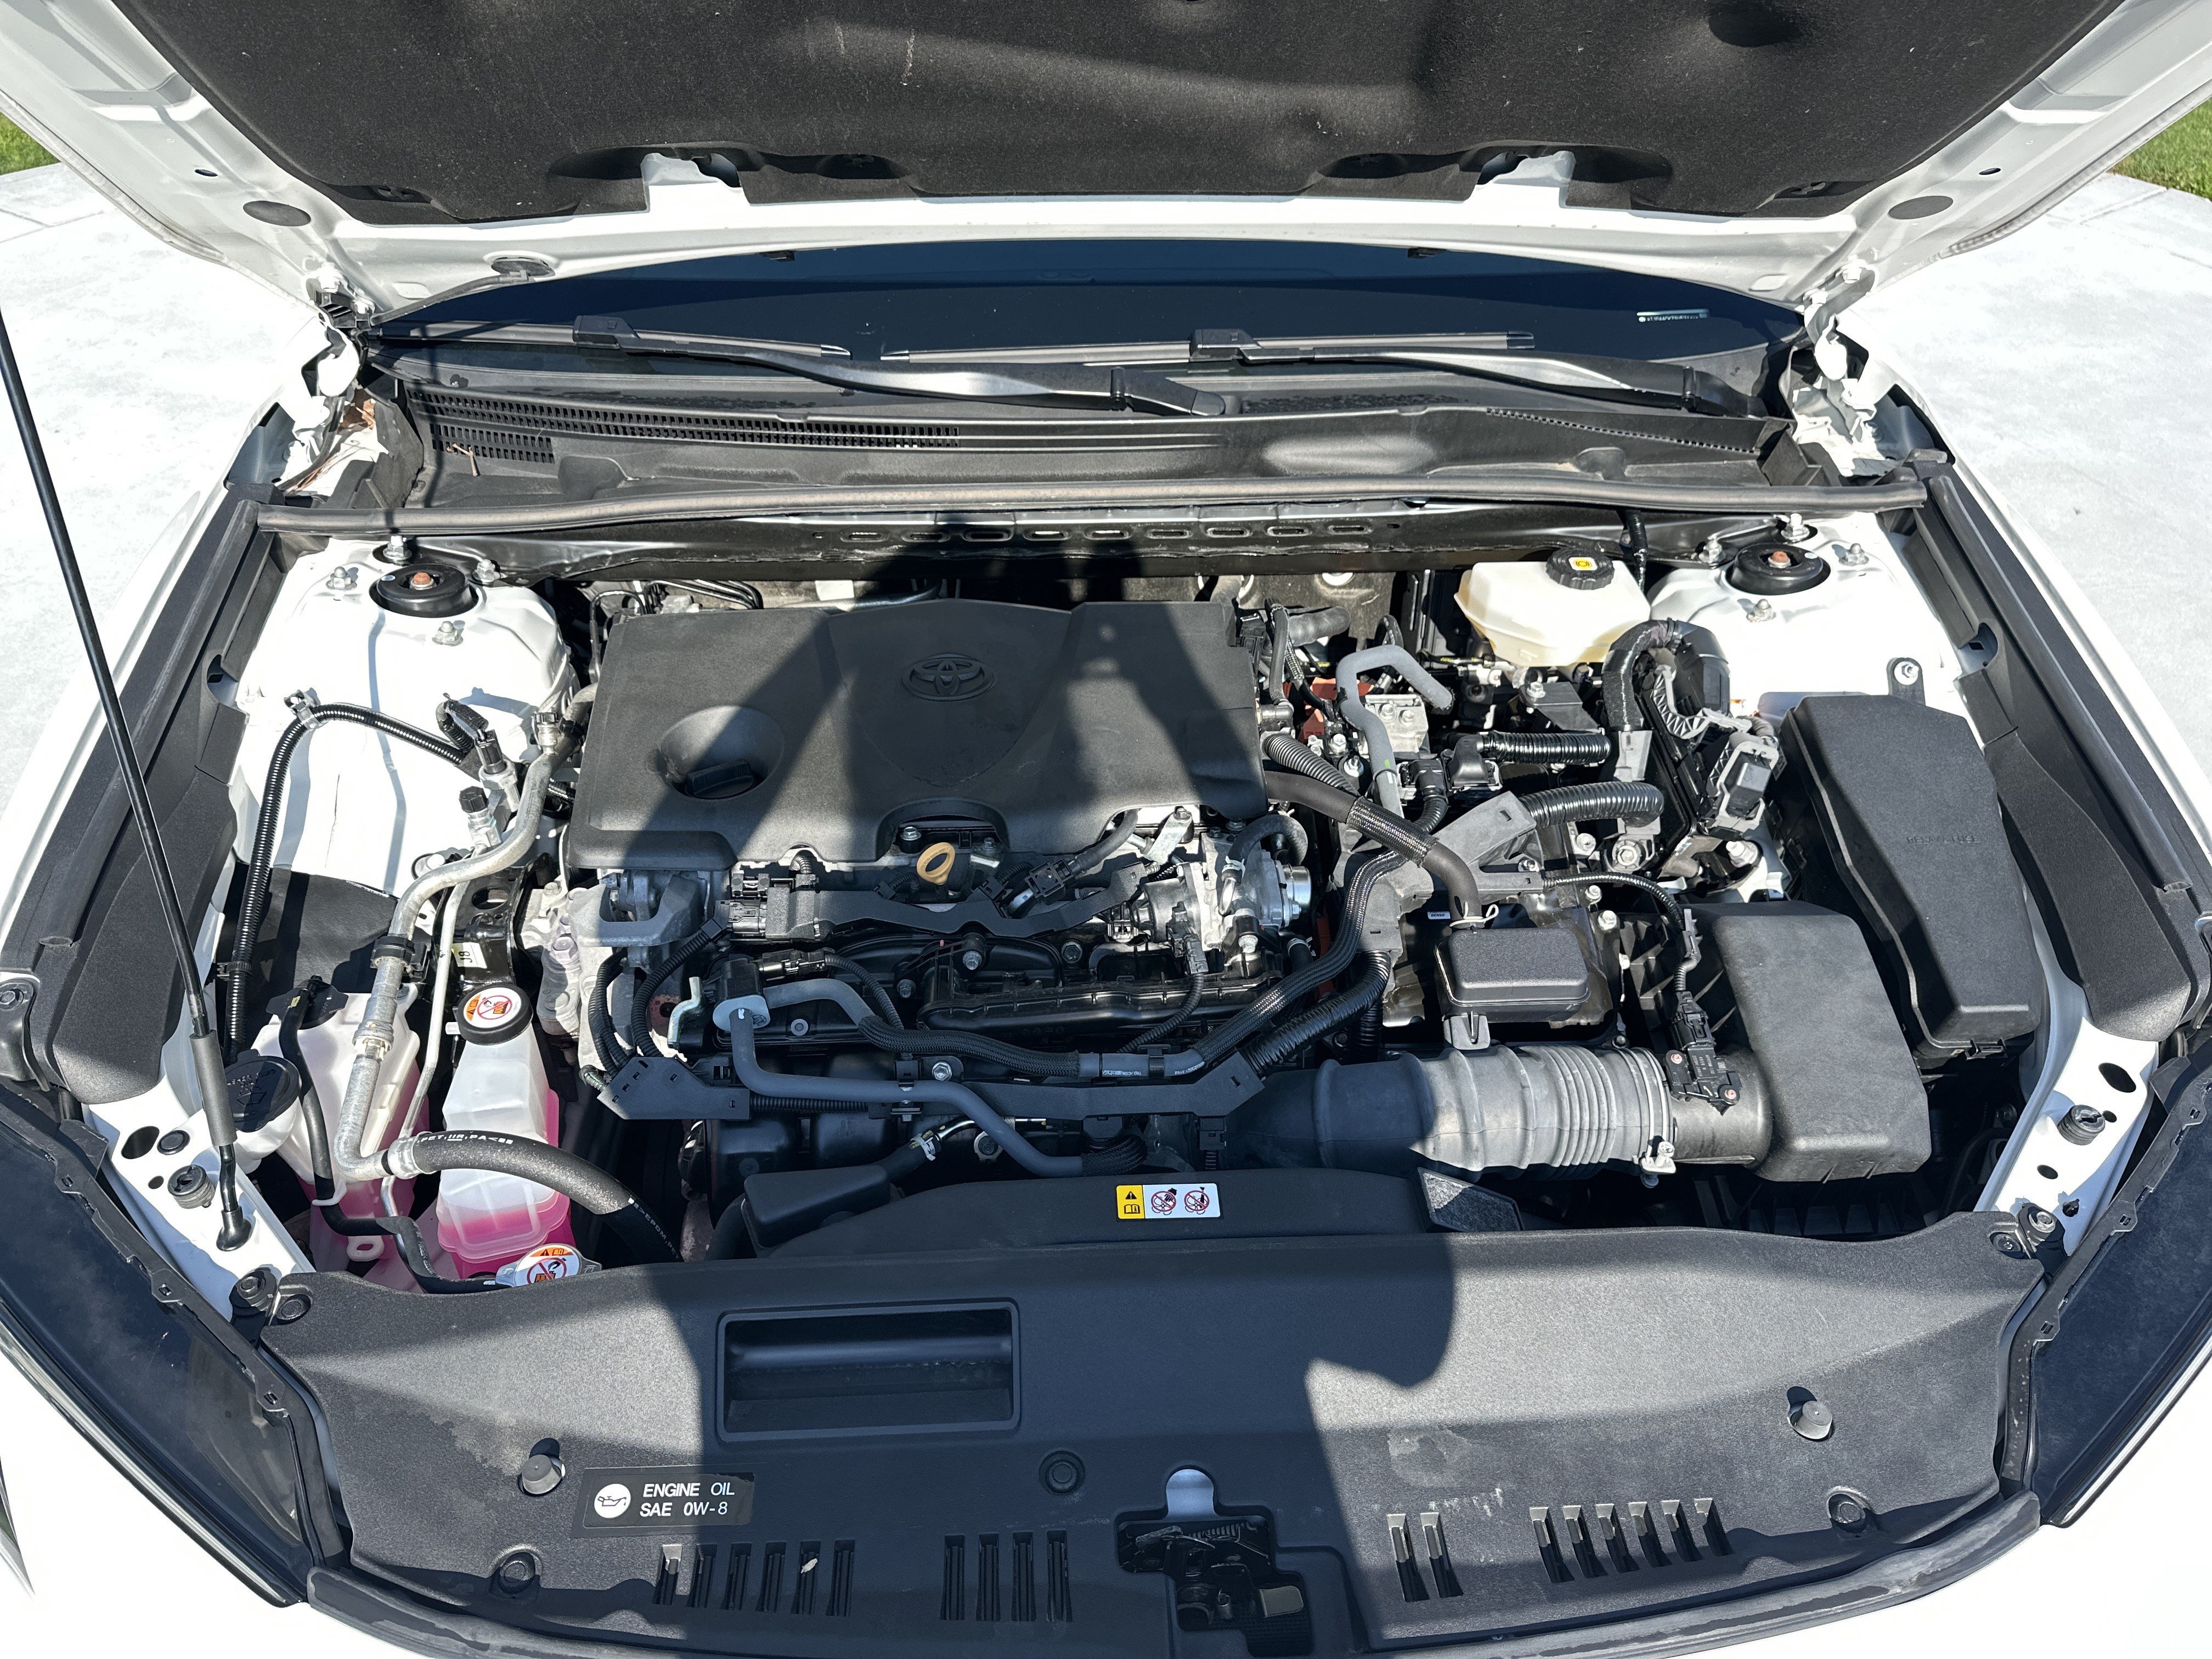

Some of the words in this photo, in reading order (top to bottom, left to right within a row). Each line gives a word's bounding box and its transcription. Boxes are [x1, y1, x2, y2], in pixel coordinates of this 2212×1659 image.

[458, 951, 473, 963] J8
[642, 1482, 701, 1497] ENGINE
[710, 1482, 735, 1496] OIL
[640, 1502, 672, 1516] SAE
[683, 1501, 728, 1516] 0W-8
